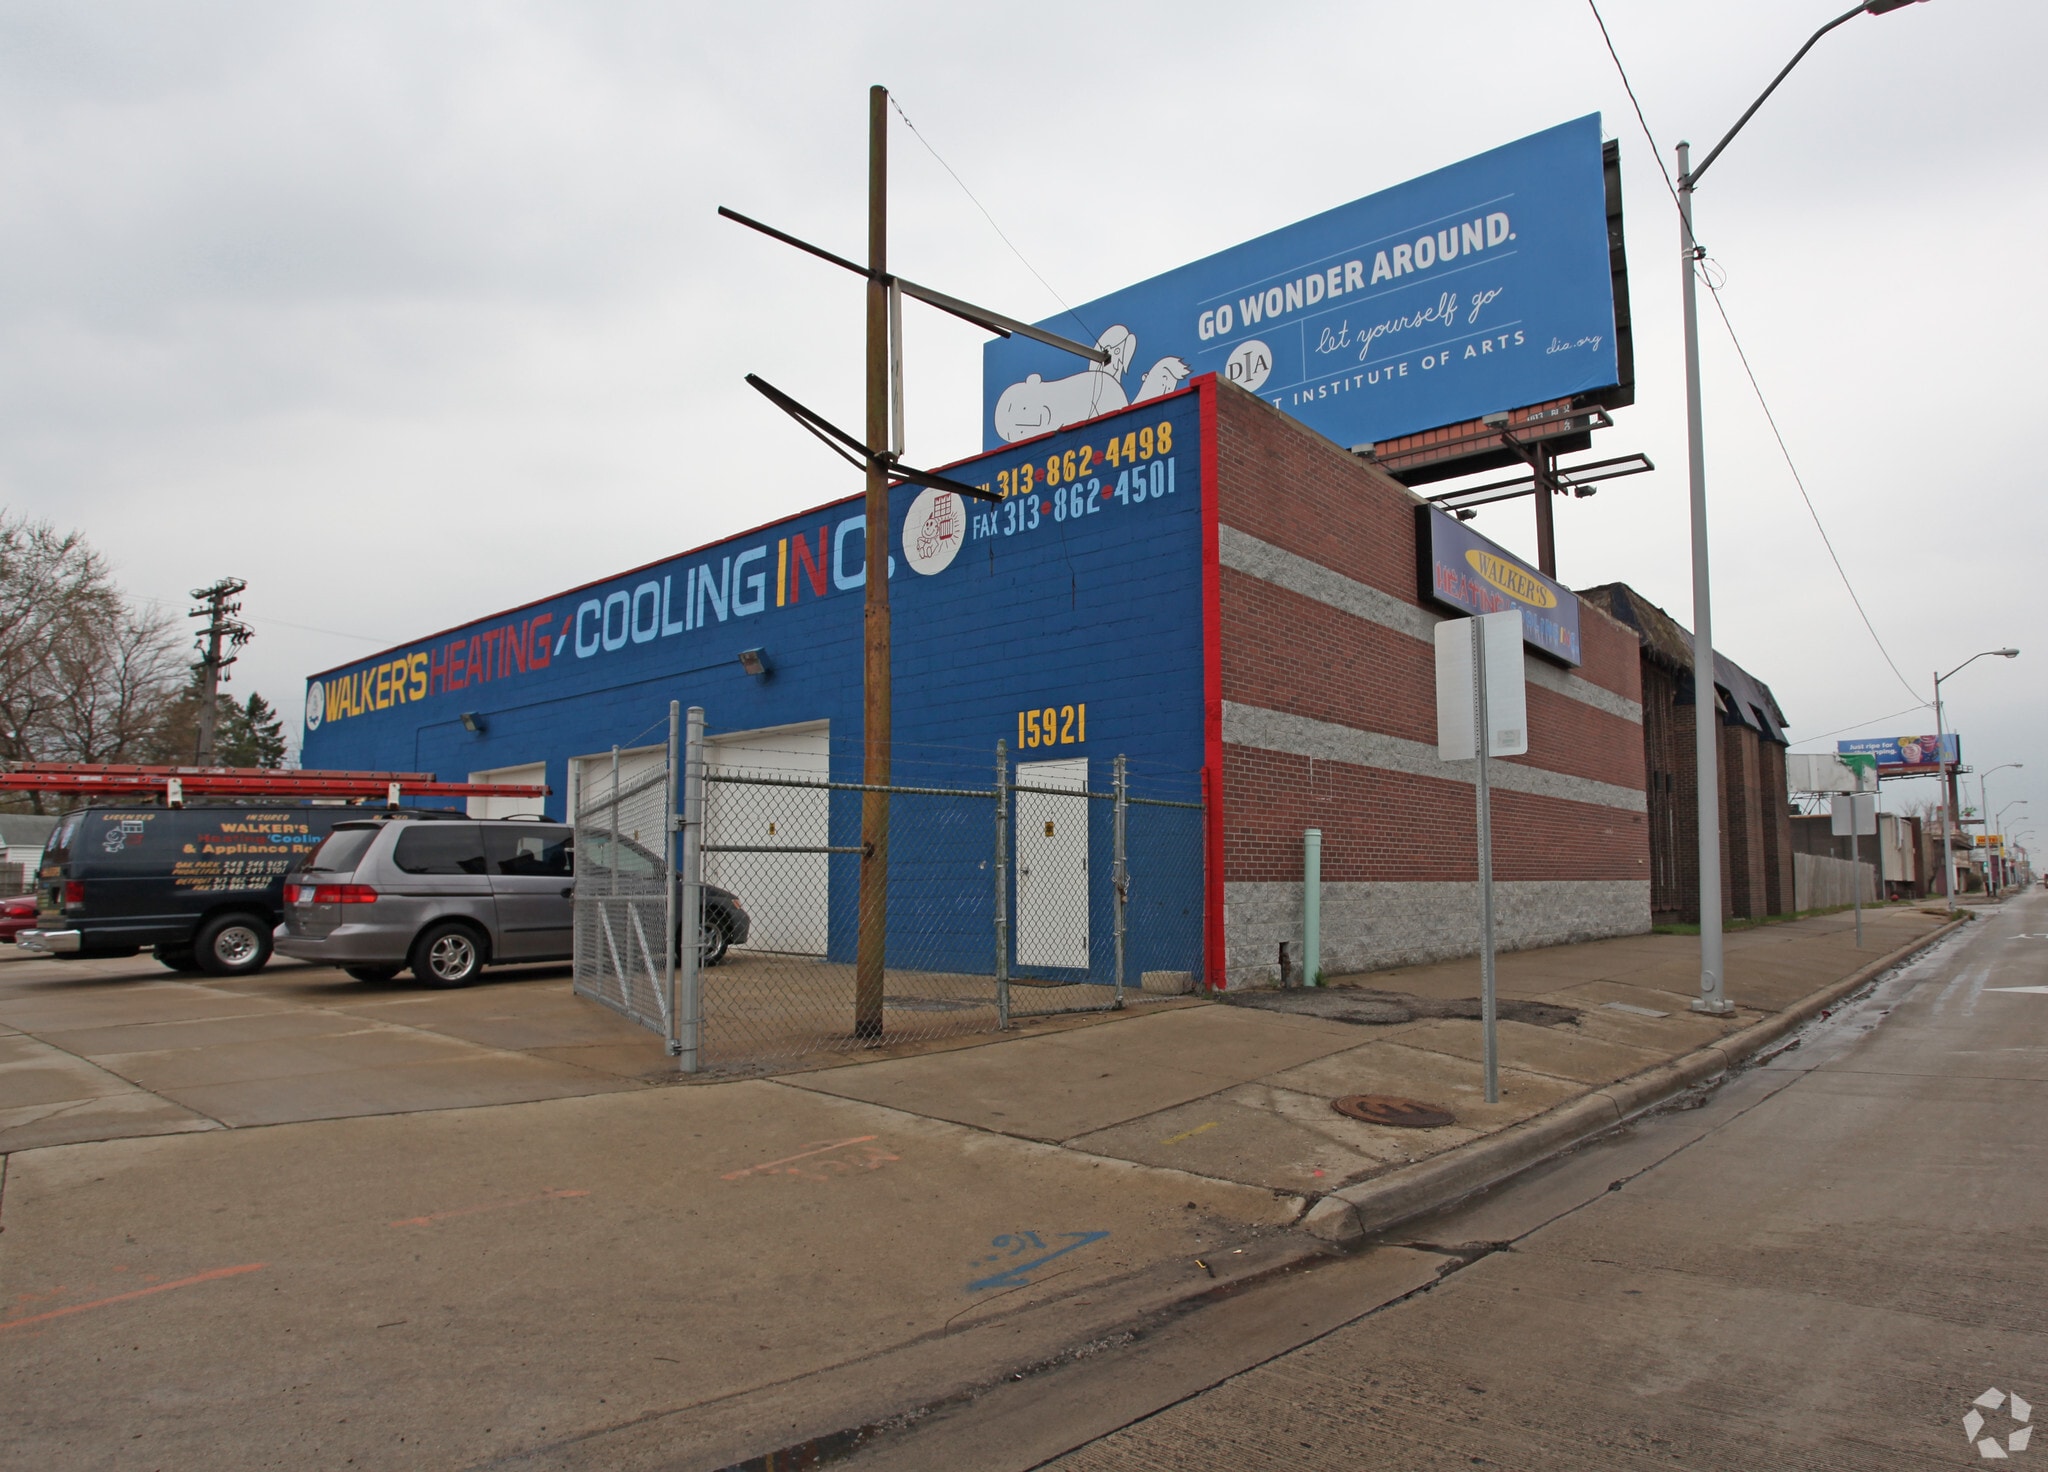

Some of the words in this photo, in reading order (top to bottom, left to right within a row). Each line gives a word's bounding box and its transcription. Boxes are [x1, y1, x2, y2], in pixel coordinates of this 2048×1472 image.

[1198, 304, 1233, 341] GO
[1239, 259, 1364, 327] WONDER
[1370, 211, 1516, 285] AROUND.
[1315, 327, 1351, 354] let
[1358, 292, 1458, 361] yourself
[1471, 286, 1503, 324] go
[1546, 335, 1603, 356] dia.org
[1228, 351, 1269, 383] DIA
[1294, 361, 1409, 406] INSTITUTE
[1421, 350, 1450, 370] OF
[1464, 329, 1525, 359] ARTS
[973, 511, 998, 541] FAX
[1478, 551, 1547, 607] WALKER'S
[325, 652, 428, 723] WALKER'S
[1018, 703, 1086, 749] 15921
[220, 823, 309, 833] WALKER'S
[270, 833, 325, 843] Coolin
[183, 844, 196, 853] &
[202, 843, 288, 855] Appliance
